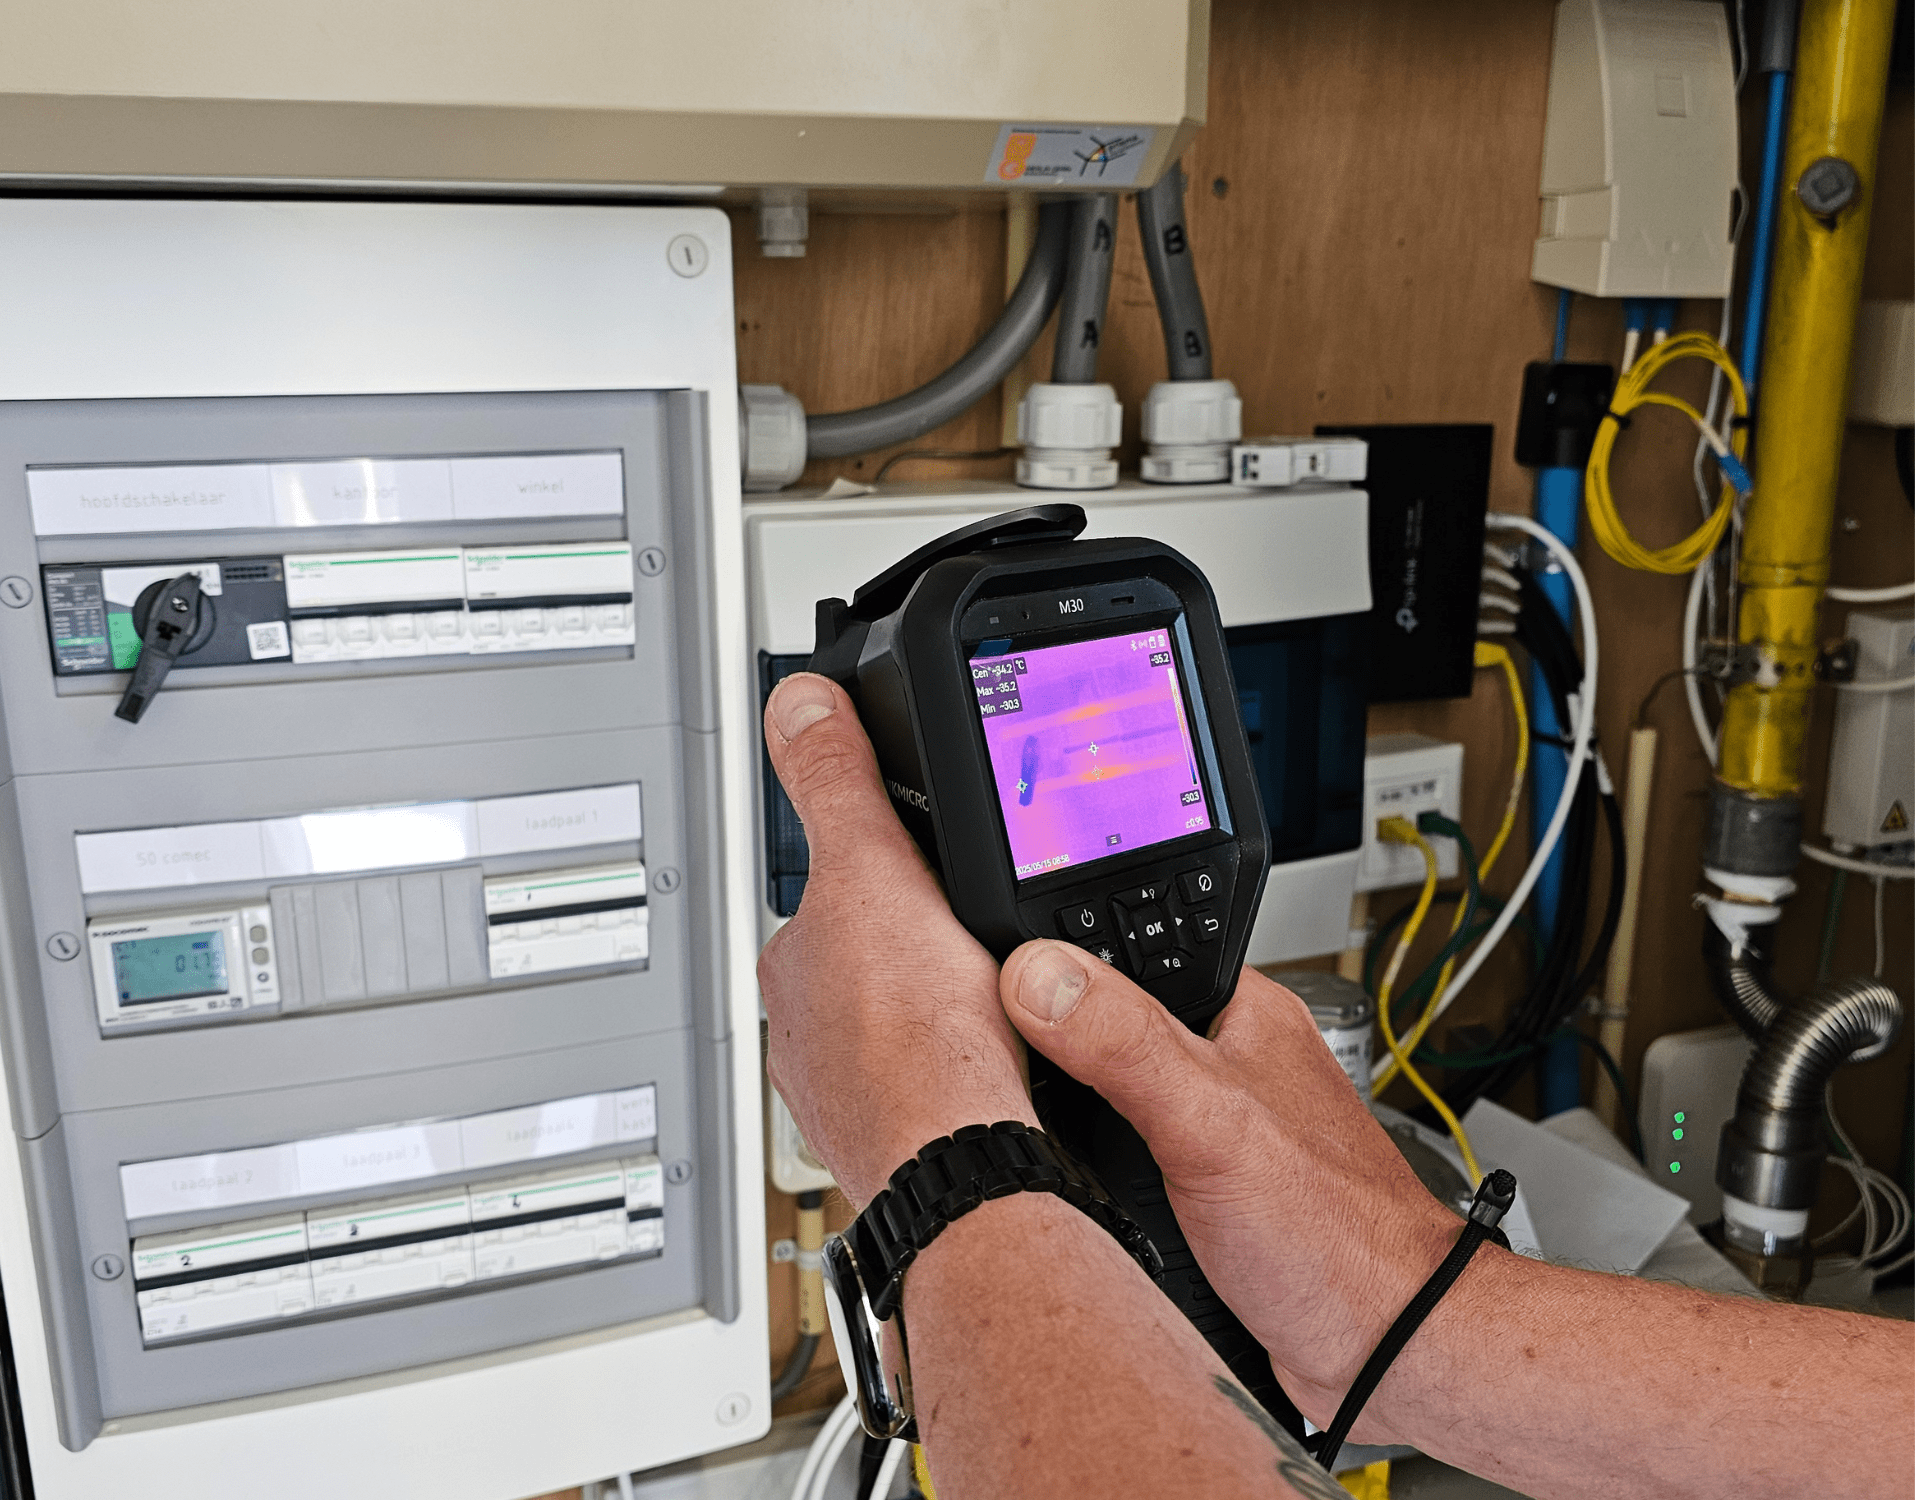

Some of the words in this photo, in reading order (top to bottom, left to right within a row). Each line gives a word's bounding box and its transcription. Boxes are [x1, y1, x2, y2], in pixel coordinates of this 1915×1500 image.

[1164, 224, 1186, 255] B
[1080, 319, 1098, 348] A
[1184, 330, 1201, 357] B
[516, 477, 564, 494] winkel
[80, 492, 226, 508] hoofdschakelaar
[1059, 598, 1084, 614] M30
[972, 669, 988, 679] Cen
[976, 686, 994, 697] Max
[980, 703, 996, 715] Min
[525, 810, 586, 831] laadpaal
[592, 808, 599, 823] 1
[162, 849, 211, 865] comec
[1146, 920, 1164, 936] OK
[342, 1144, 407, 1168] laadpaal
[171, 1171, 239, 1192] laadpaal
[180, 1254, 194, 1267] 2
